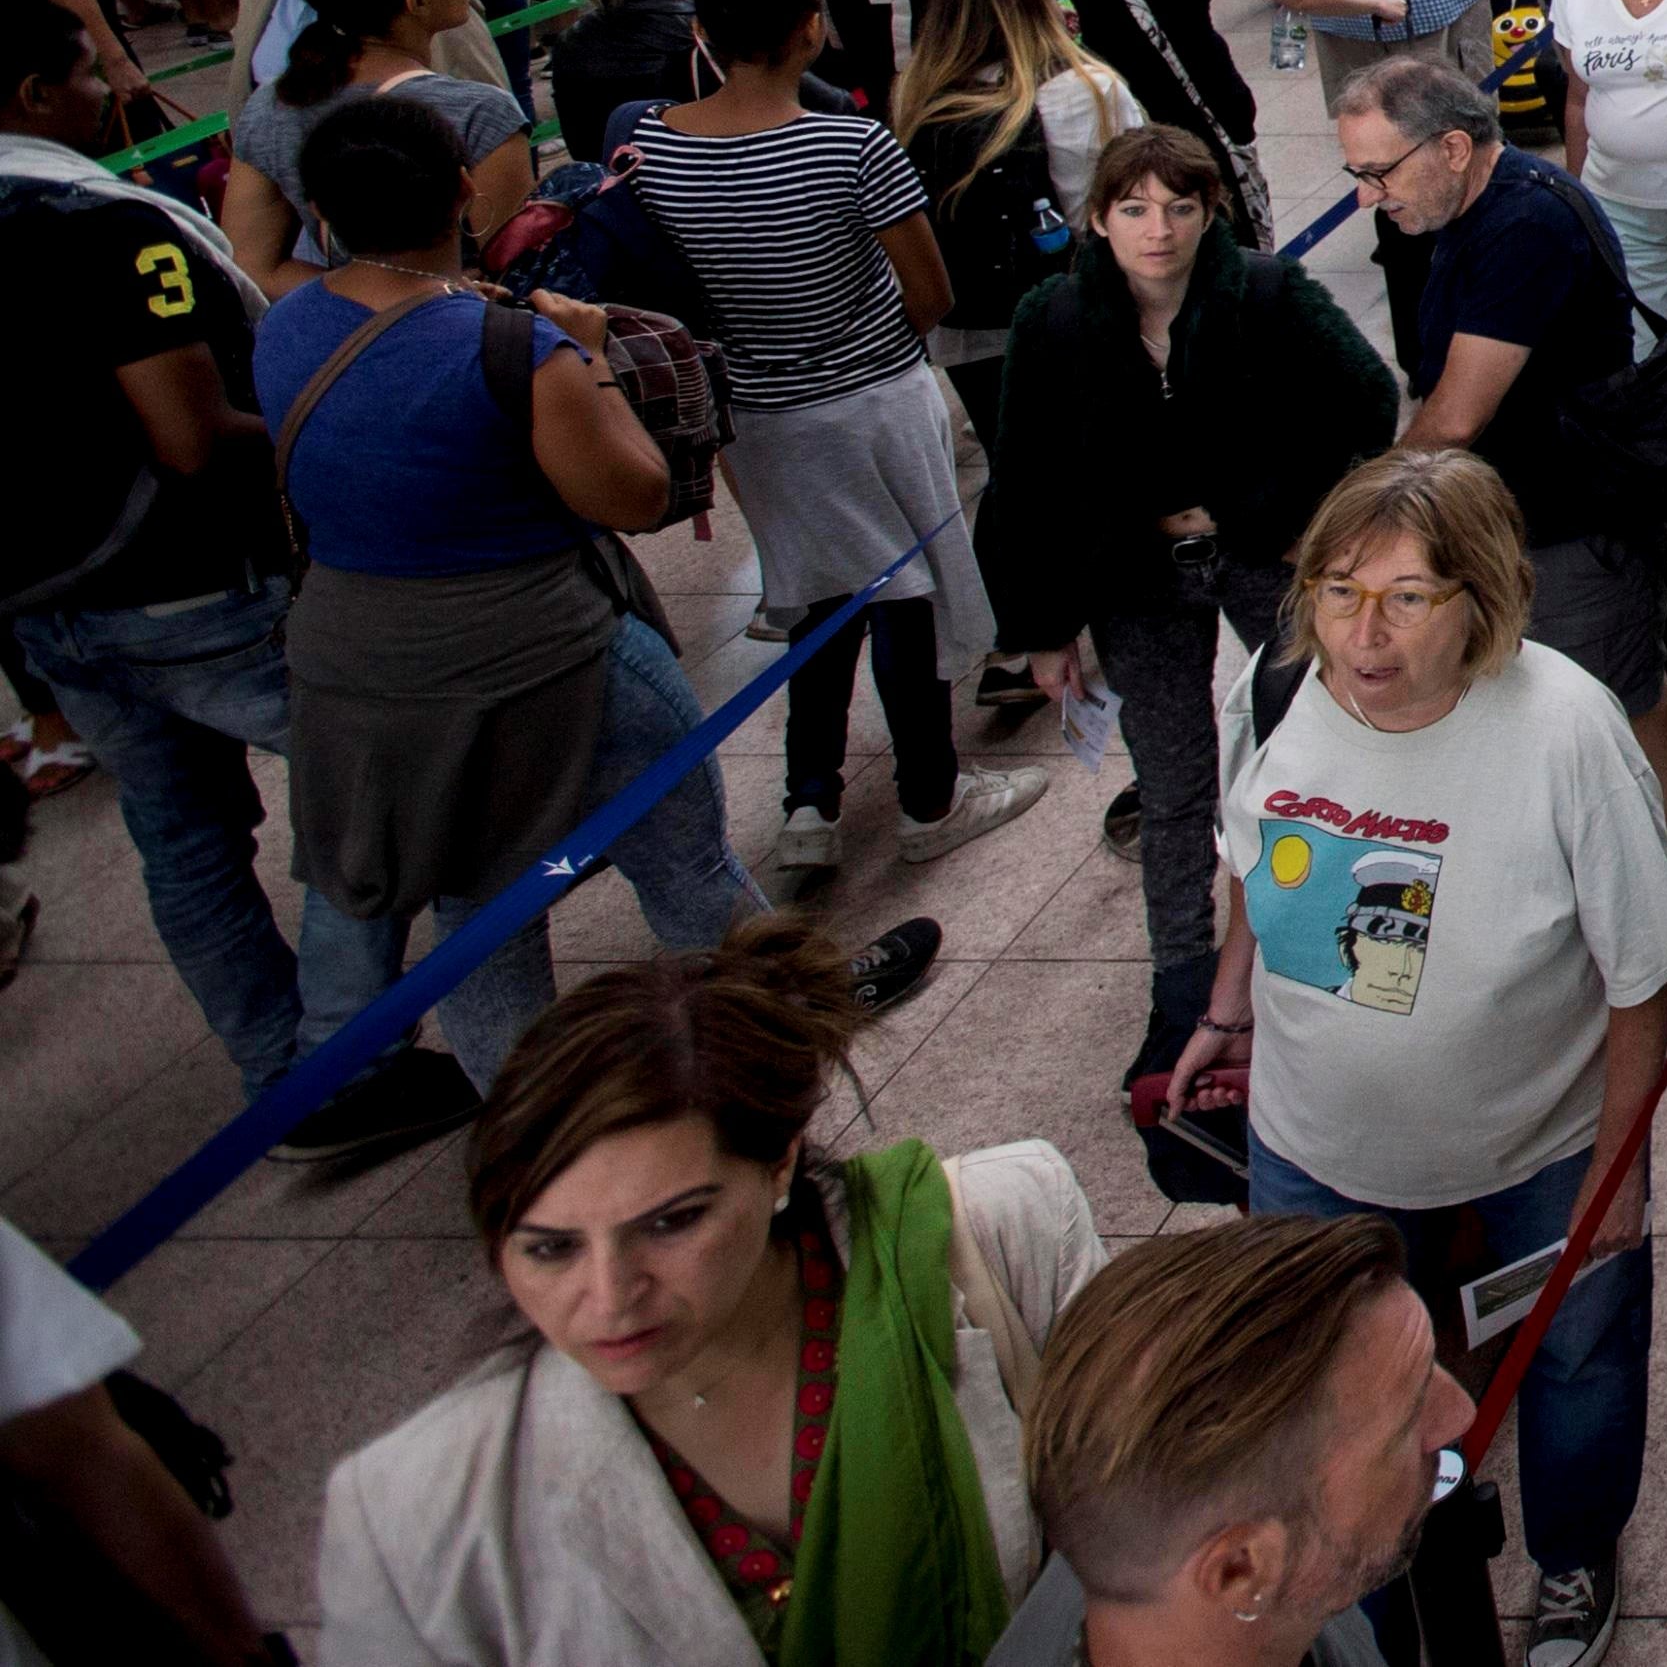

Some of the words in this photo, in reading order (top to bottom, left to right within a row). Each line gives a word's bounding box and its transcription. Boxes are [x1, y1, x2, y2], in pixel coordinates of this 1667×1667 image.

[1583, 47, 1642, 76] Paris
[136, 243, 196, 318] 3
[1264, 789, 1353, 827] CORTO
